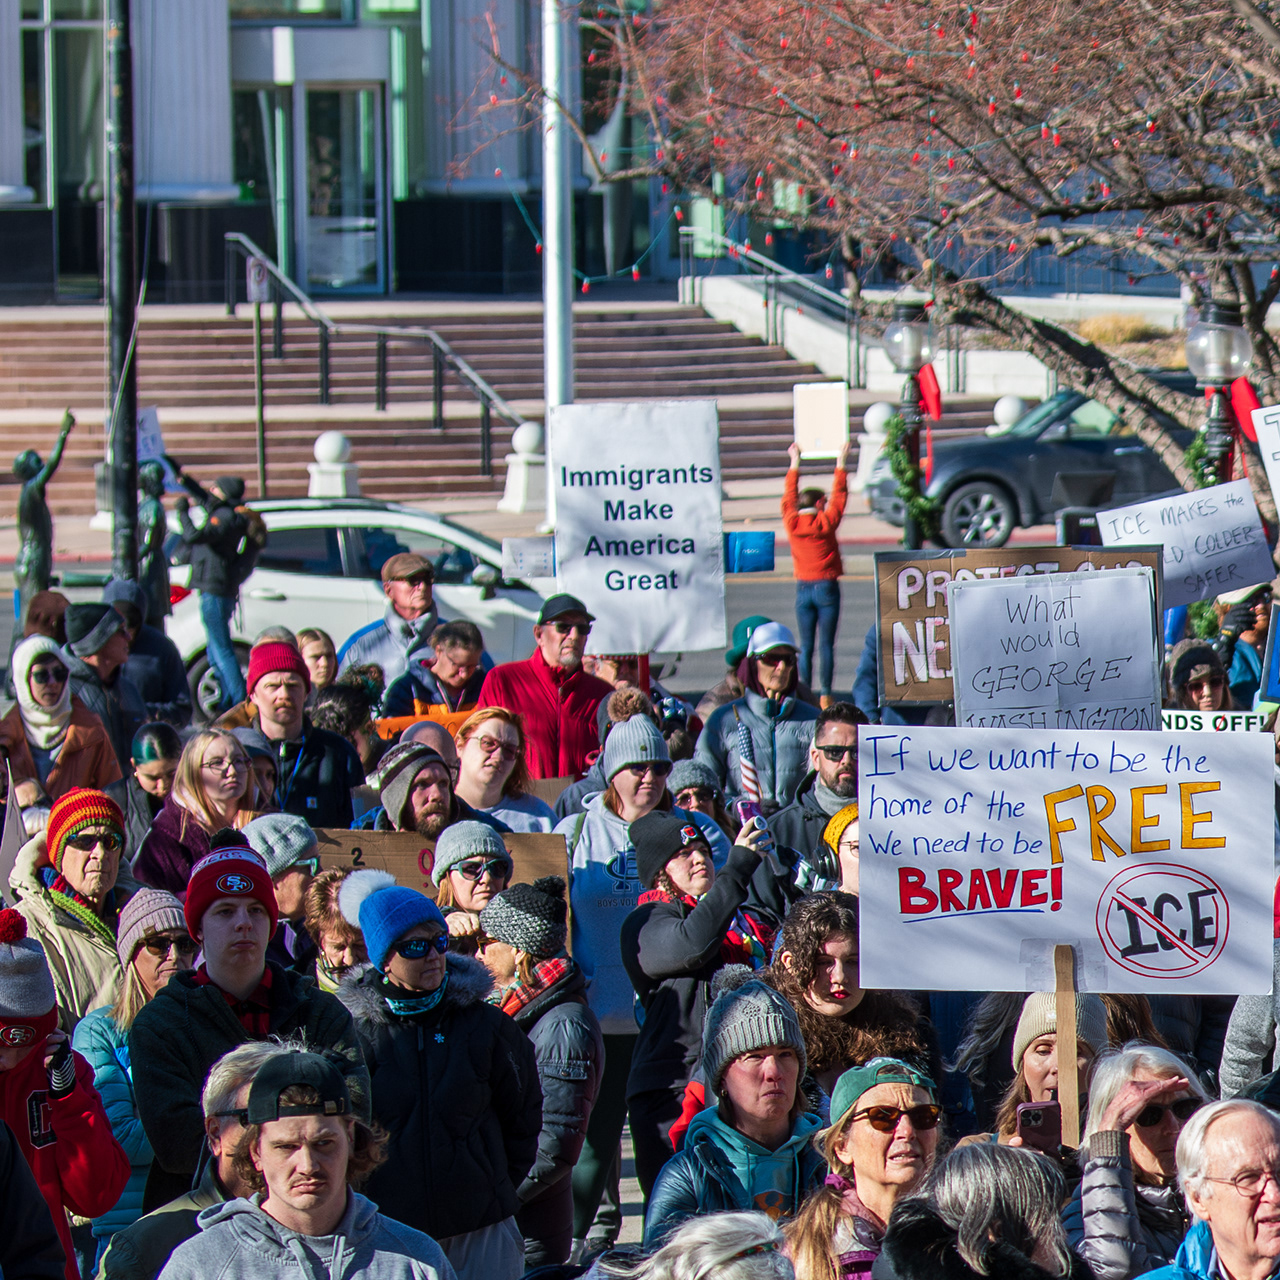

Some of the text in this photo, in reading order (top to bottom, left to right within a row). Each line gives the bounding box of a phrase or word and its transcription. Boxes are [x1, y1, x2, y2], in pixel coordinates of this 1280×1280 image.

[561, 463, 713, 490] Immigrants
[604, 499, 673, 521] Make
[1108, 493, 1244, 542] ICE MAKES the
[584, 534, 695, 556] America
[1194, 526, 1256, 556] COLDER
[605, 570, 678, 591] Great
[1183, 563, 1245, 593] SAFER
[1006, 586, 1081, 624] What
[1001, 622, 1080, 655] would
[972, 656, 1133, 699] GEORGE
[865, 735, 1211, 777] If we want to be the
[869, 781, 1226, 865] home of the FREE
[869, 830, 1043, 856] We need to be
[898, 866, 1063, 915] BRAVE!
[1115, 889, 1217, 958] ICE
